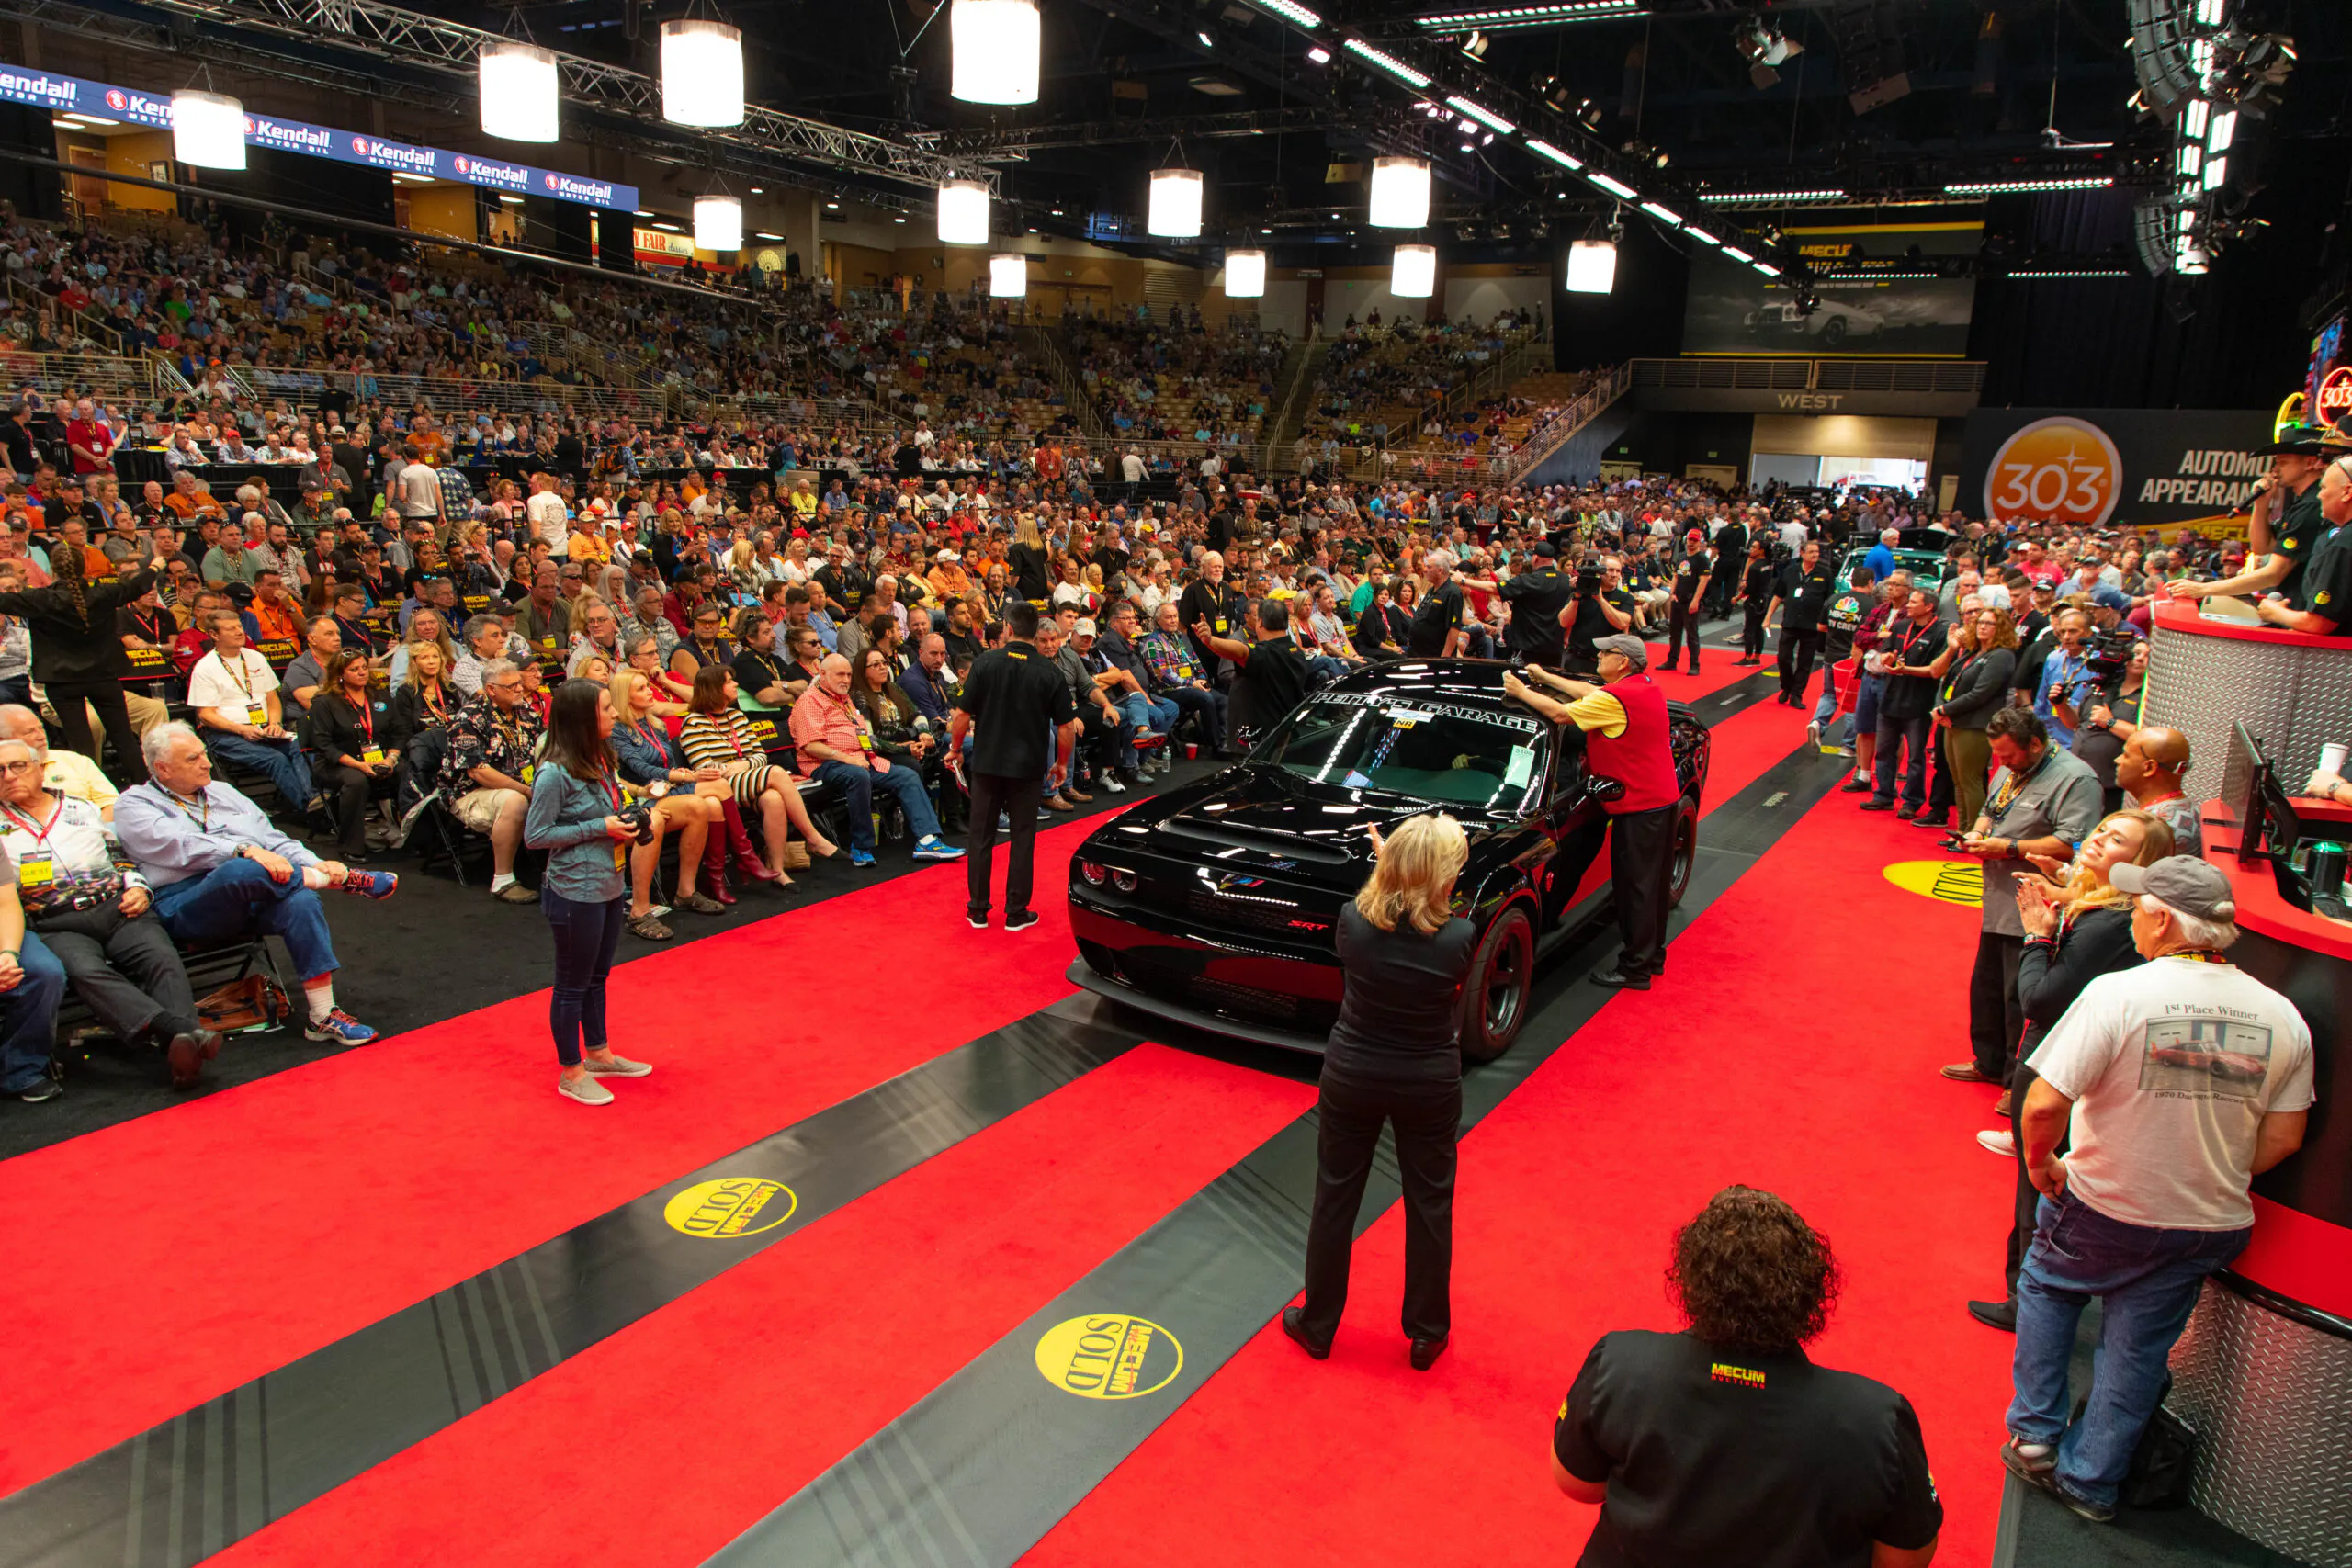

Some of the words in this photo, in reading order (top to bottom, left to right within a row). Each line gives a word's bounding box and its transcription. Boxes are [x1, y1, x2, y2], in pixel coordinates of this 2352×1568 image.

[0, 73, 76, 100] endall
[256, 137, 300, 150] MOTOR
[257, 120, 331, 147] Kendall
[369, 156, 408, 169] MOTOR
[370, 142, 435, 166] Kendall
[470, 161, 528, 184] Kendall
[560, 178, 612, 200] Kendall
[643, 233, 666, 252] FAIR
[1799, 243, 1853, 257] MECU
[1778, 394, 1843, 410] WEST
[2178, 449, 2276, 477] AUTOMO
[1996, 463, 2106, 514] 303
[2139, 478, 2255, 506] APPEARAN
[1311, 692, 1413, 711] PETTY'S
[1419, 702, 1539, 733] GARAGE
[1396, 719, 1414, 728] NR
[1287, 919, 1329, 931] SRT
[2165, 1003, 2180, 1015] 1st
[2184, 1004, 2214, 1015] Place
[2217, 1005, 2259, 1021] Winner
[684, 1180, 753, 1232] SOLD
[719, 1185, 780, 1234] MECUM
[1065, 1317, 1123, 1391] SOLD
[1109, 1325, 1153, 1393] MECUM
[1711, 1374, 1765, 1390] AUCTIONS
[1712, 1362, 1766, 1383] MECUM
